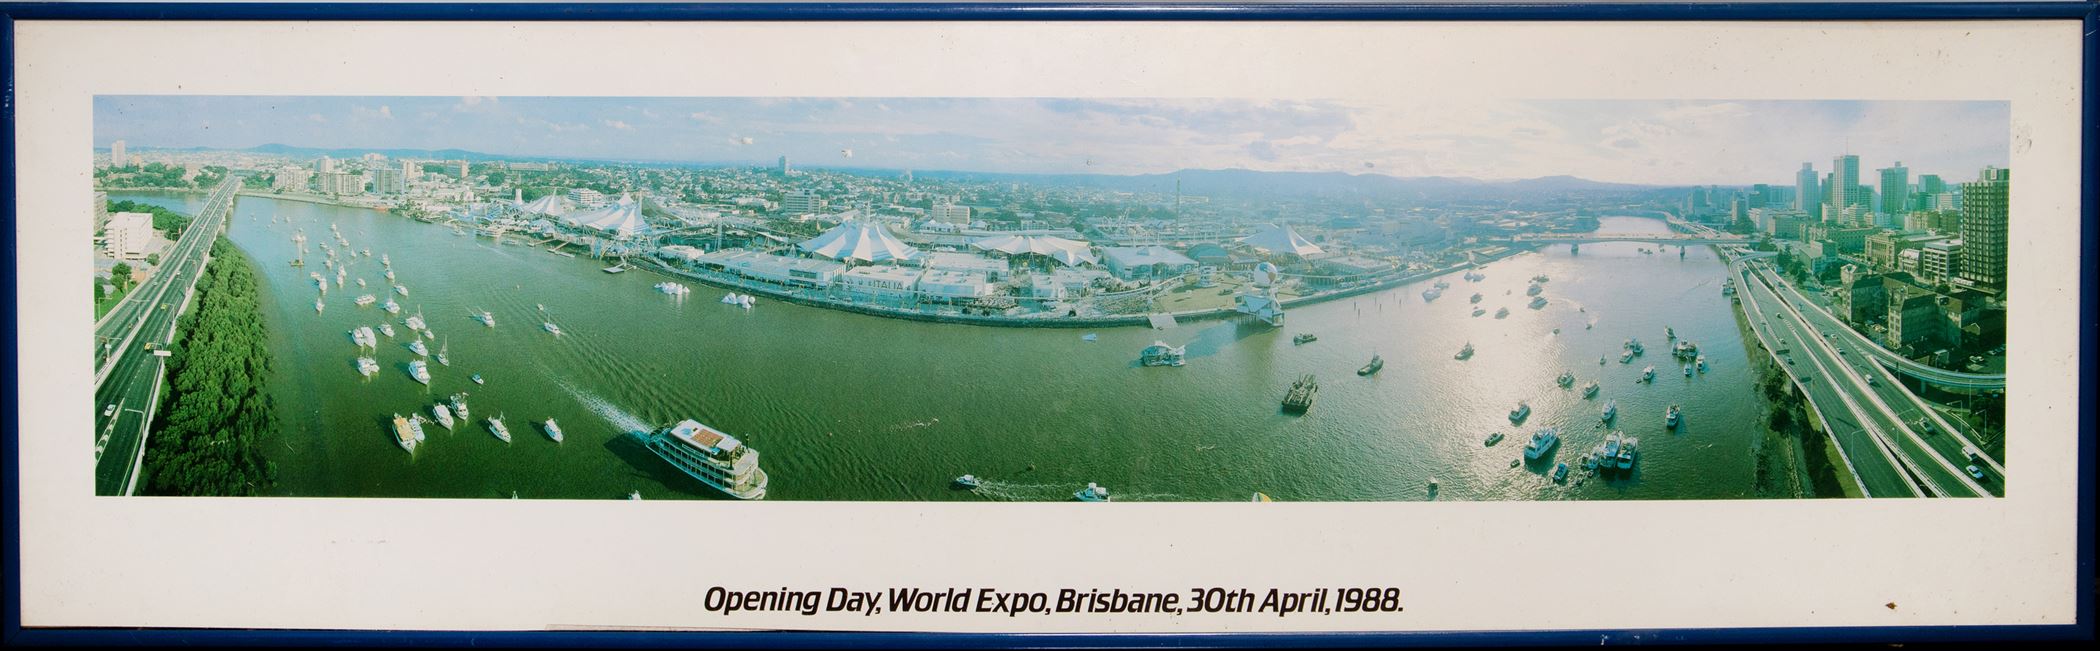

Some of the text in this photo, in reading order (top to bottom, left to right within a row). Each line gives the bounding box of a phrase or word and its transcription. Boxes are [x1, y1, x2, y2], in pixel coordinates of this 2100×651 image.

[872, 279, 903, 290] ITALIA
[704, 587, 1404, 617] Opening Day, World Expo, Brisbane, 30th April, 1988.
